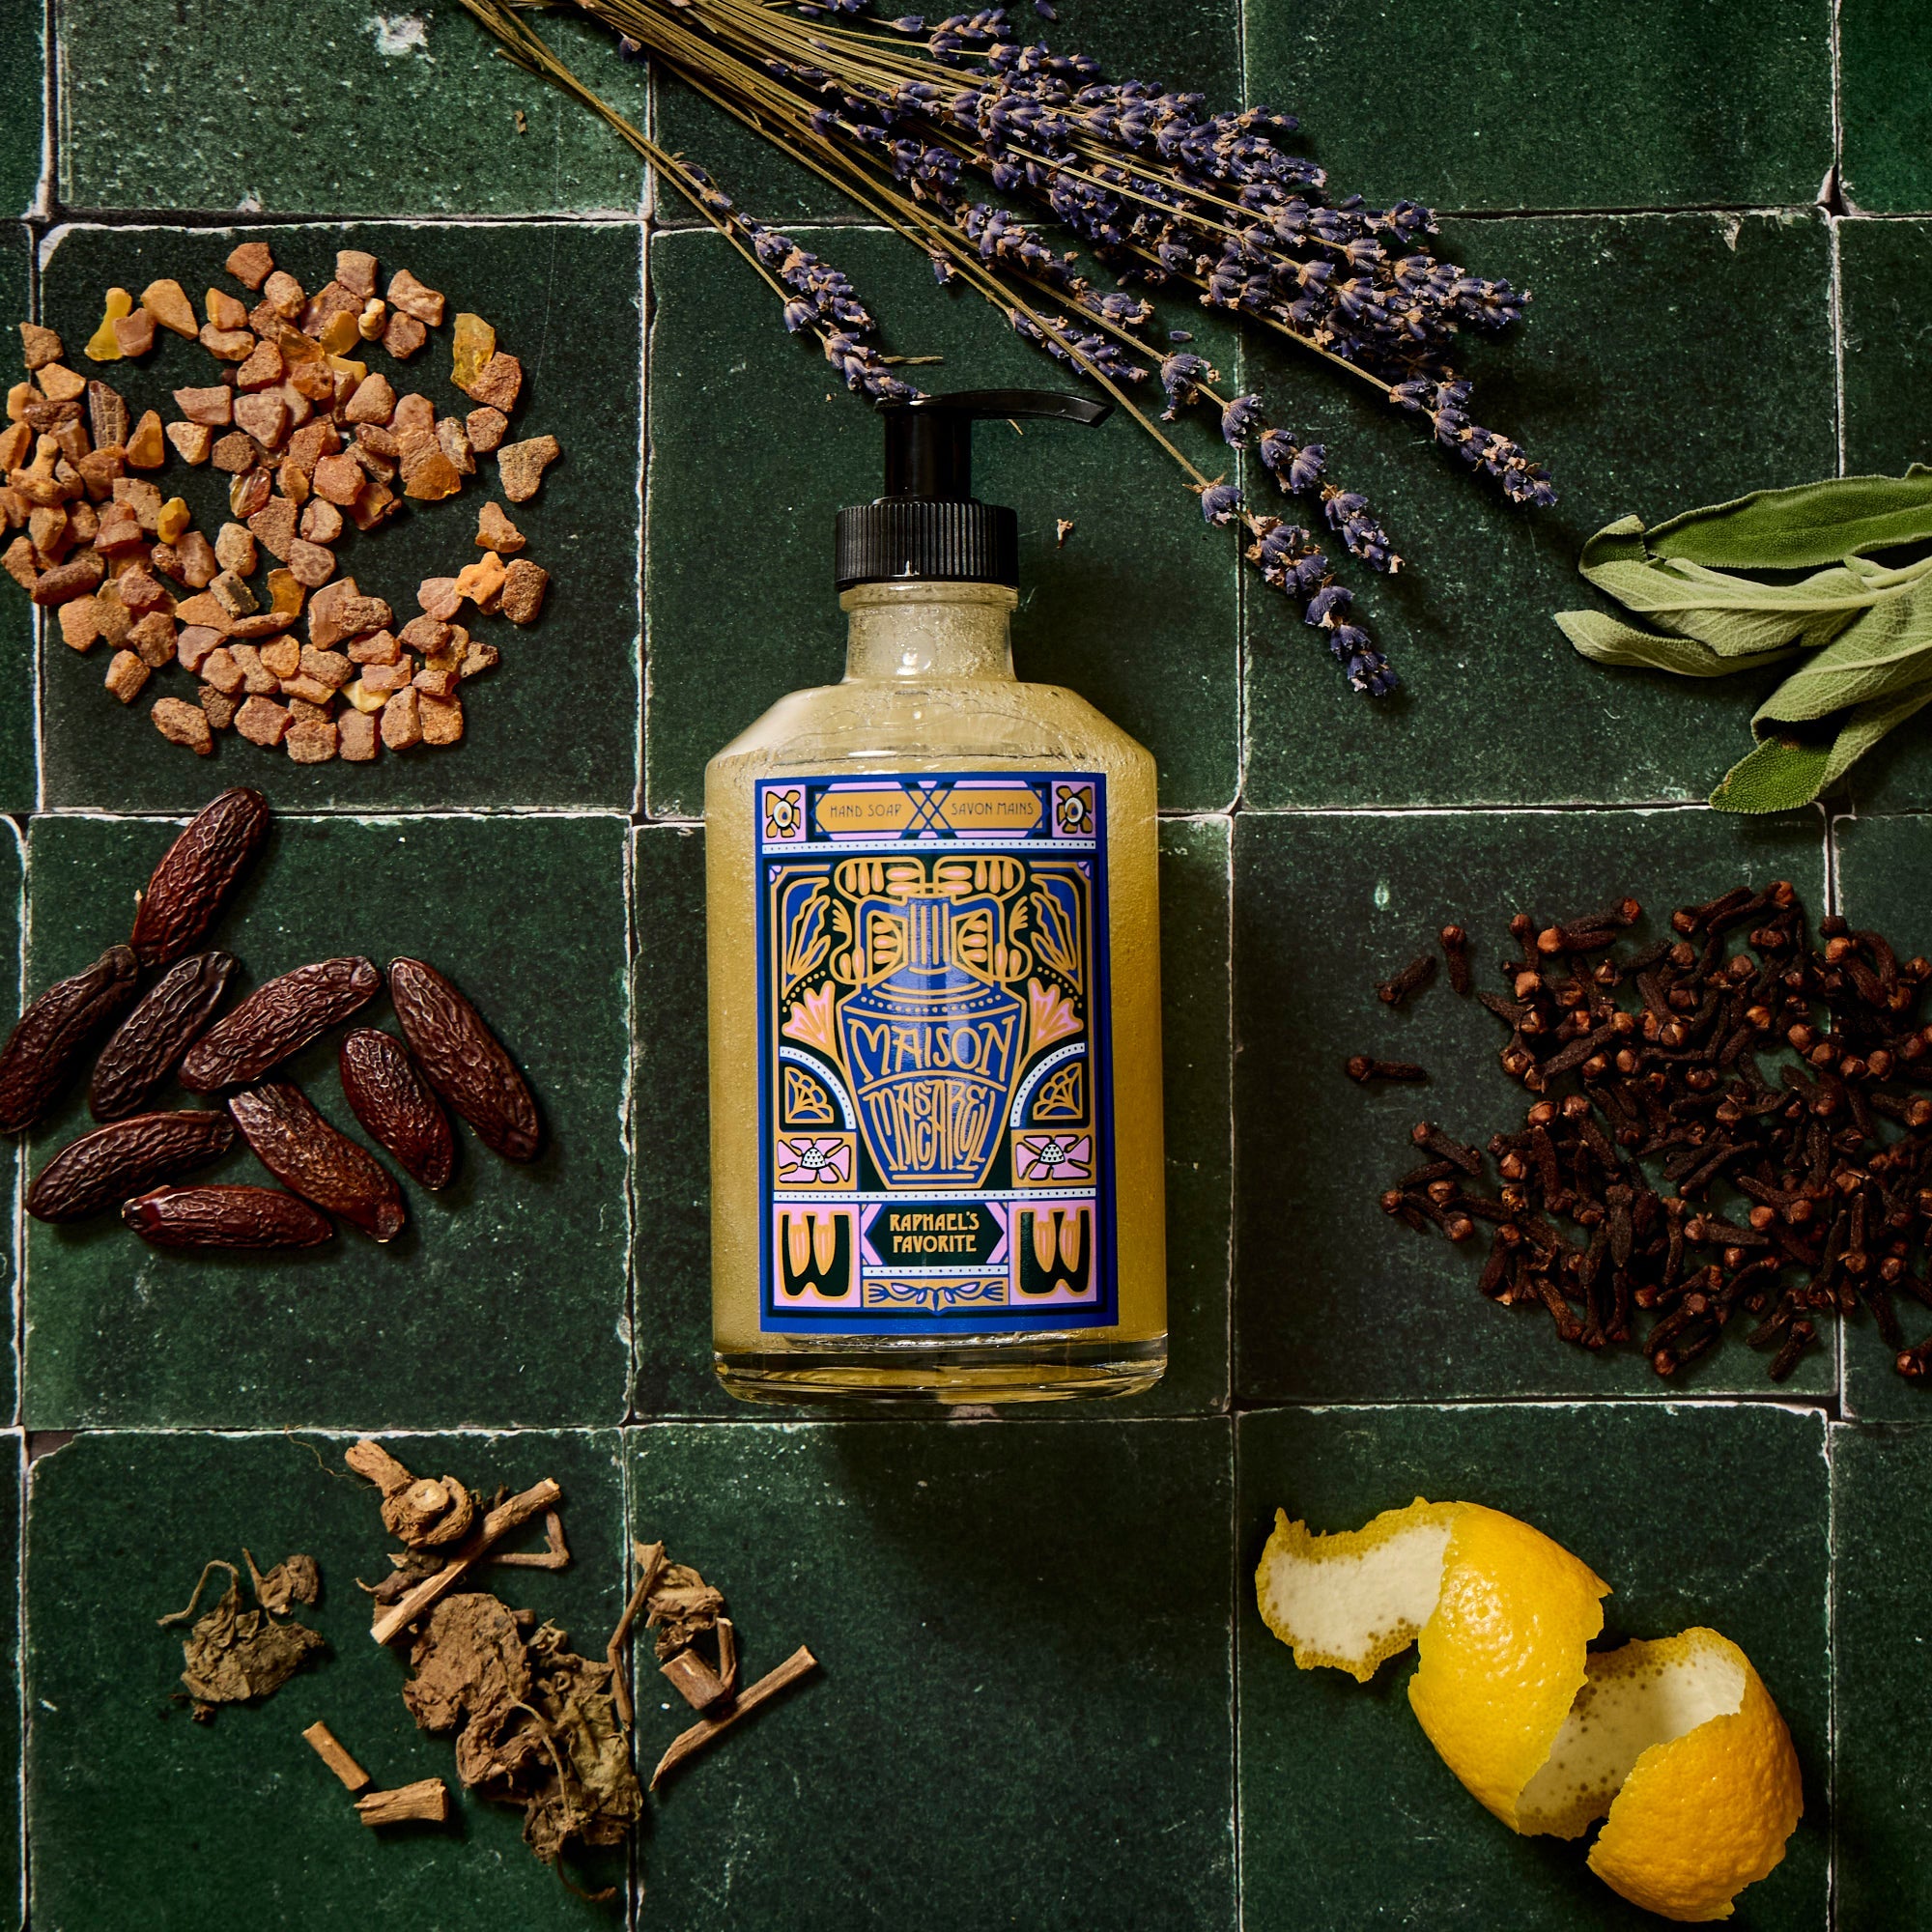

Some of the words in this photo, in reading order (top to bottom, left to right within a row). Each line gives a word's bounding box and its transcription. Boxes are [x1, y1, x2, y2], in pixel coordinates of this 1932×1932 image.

[830, 805, 863, 818] HAND
[867, 803, 902, 817] SOAP
[951, 802, 992, 815] SAVON
[997, 802, 1034, 815] MAINS
[846, 1014, 1016, 1083] MAISON
[889, 1210, 980, 1232] RAPHAEL'S
[893, 1235, 977, 1253] FAVORITE
